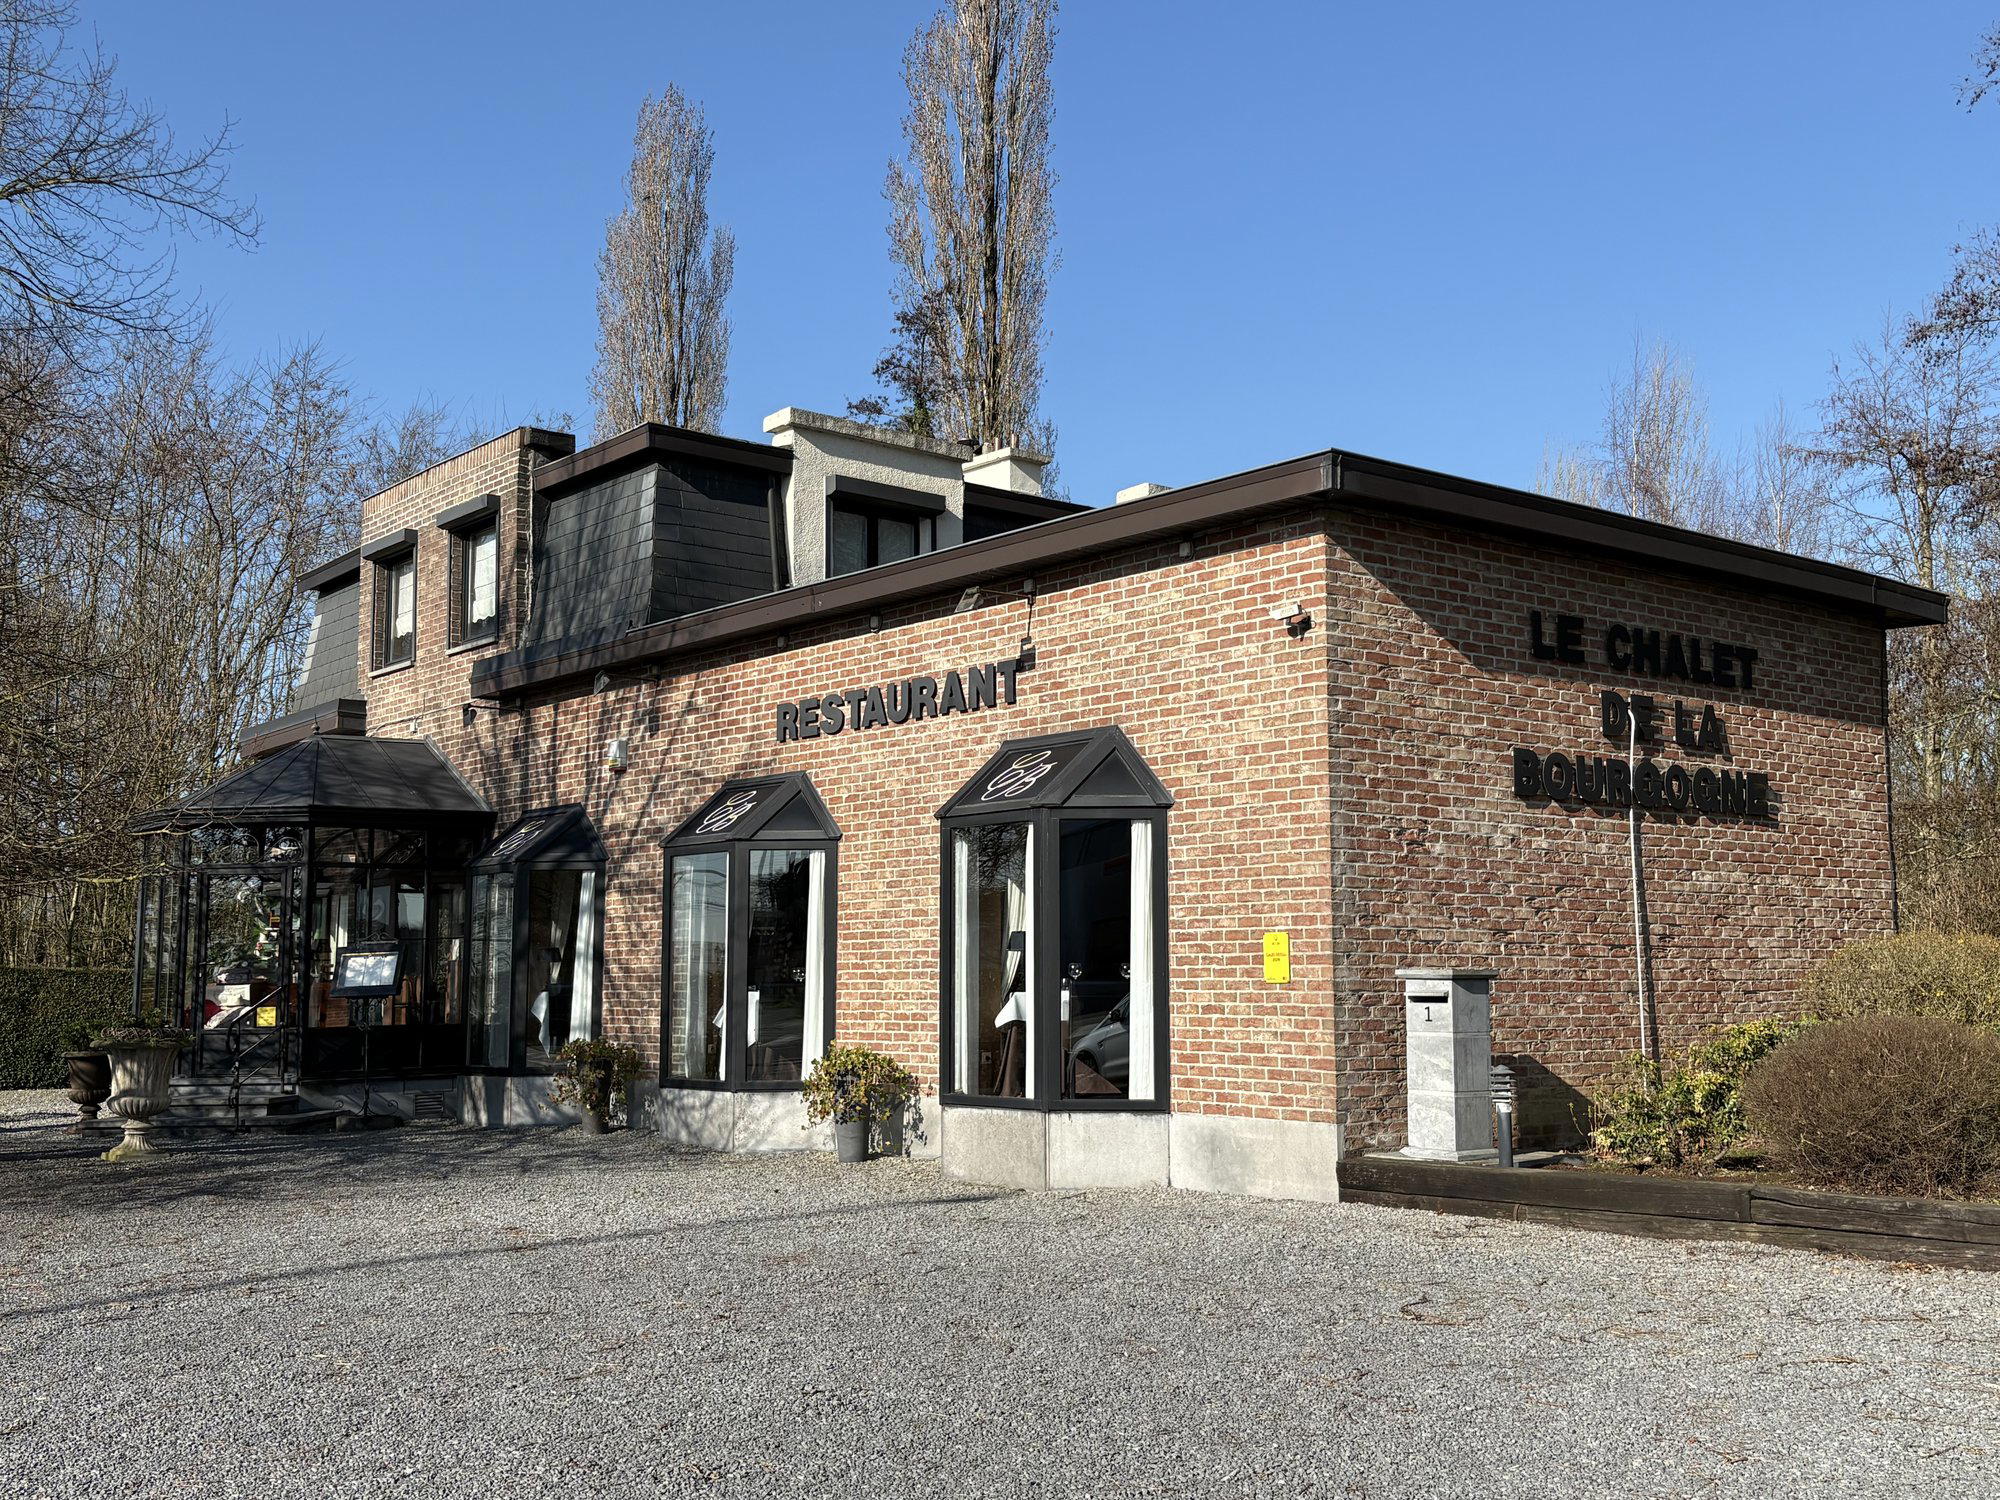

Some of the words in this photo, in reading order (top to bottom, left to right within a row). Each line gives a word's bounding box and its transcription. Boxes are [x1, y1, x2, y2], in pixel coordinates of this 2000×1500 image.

[1530, 610, 1586, 664] LE
[1605, 623, 1759, 689] CHALET
[776, 658, 1019, 743] RESTAURANT
[1599, 690, 1655, 743] DE
[1673, 699, 1722, 753] LA
[1512, 747, 1770, 817] BOURGOGNE
[1424, 1005, 1433, 1022] 1
